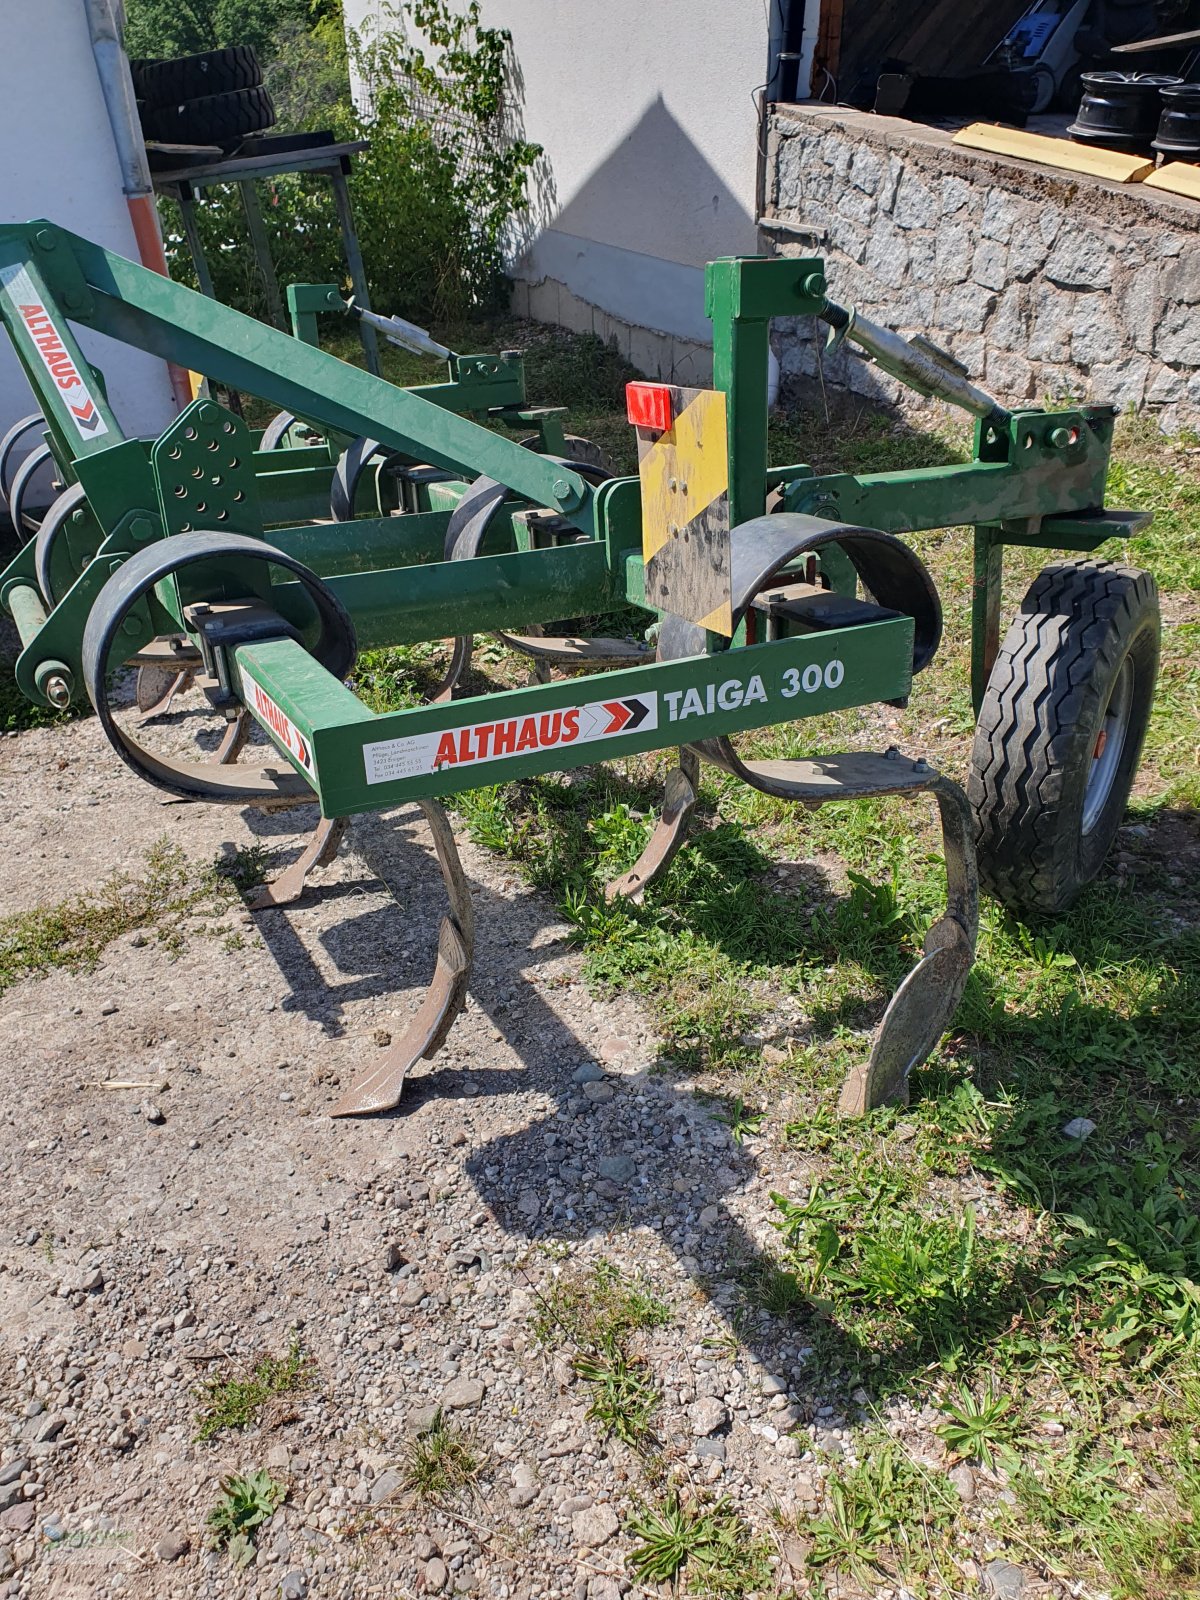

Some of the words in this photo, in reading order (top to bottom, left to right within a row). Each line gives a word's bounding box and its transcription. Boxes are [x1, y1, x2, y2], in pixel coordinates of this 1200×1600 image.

[18, 304, 82, 390] ALTHAUS
[663, 674, 769, 722] TAIGA
[780, 659, 845, 698] 300
[433, 709, 580, 768] ALTHAUS
